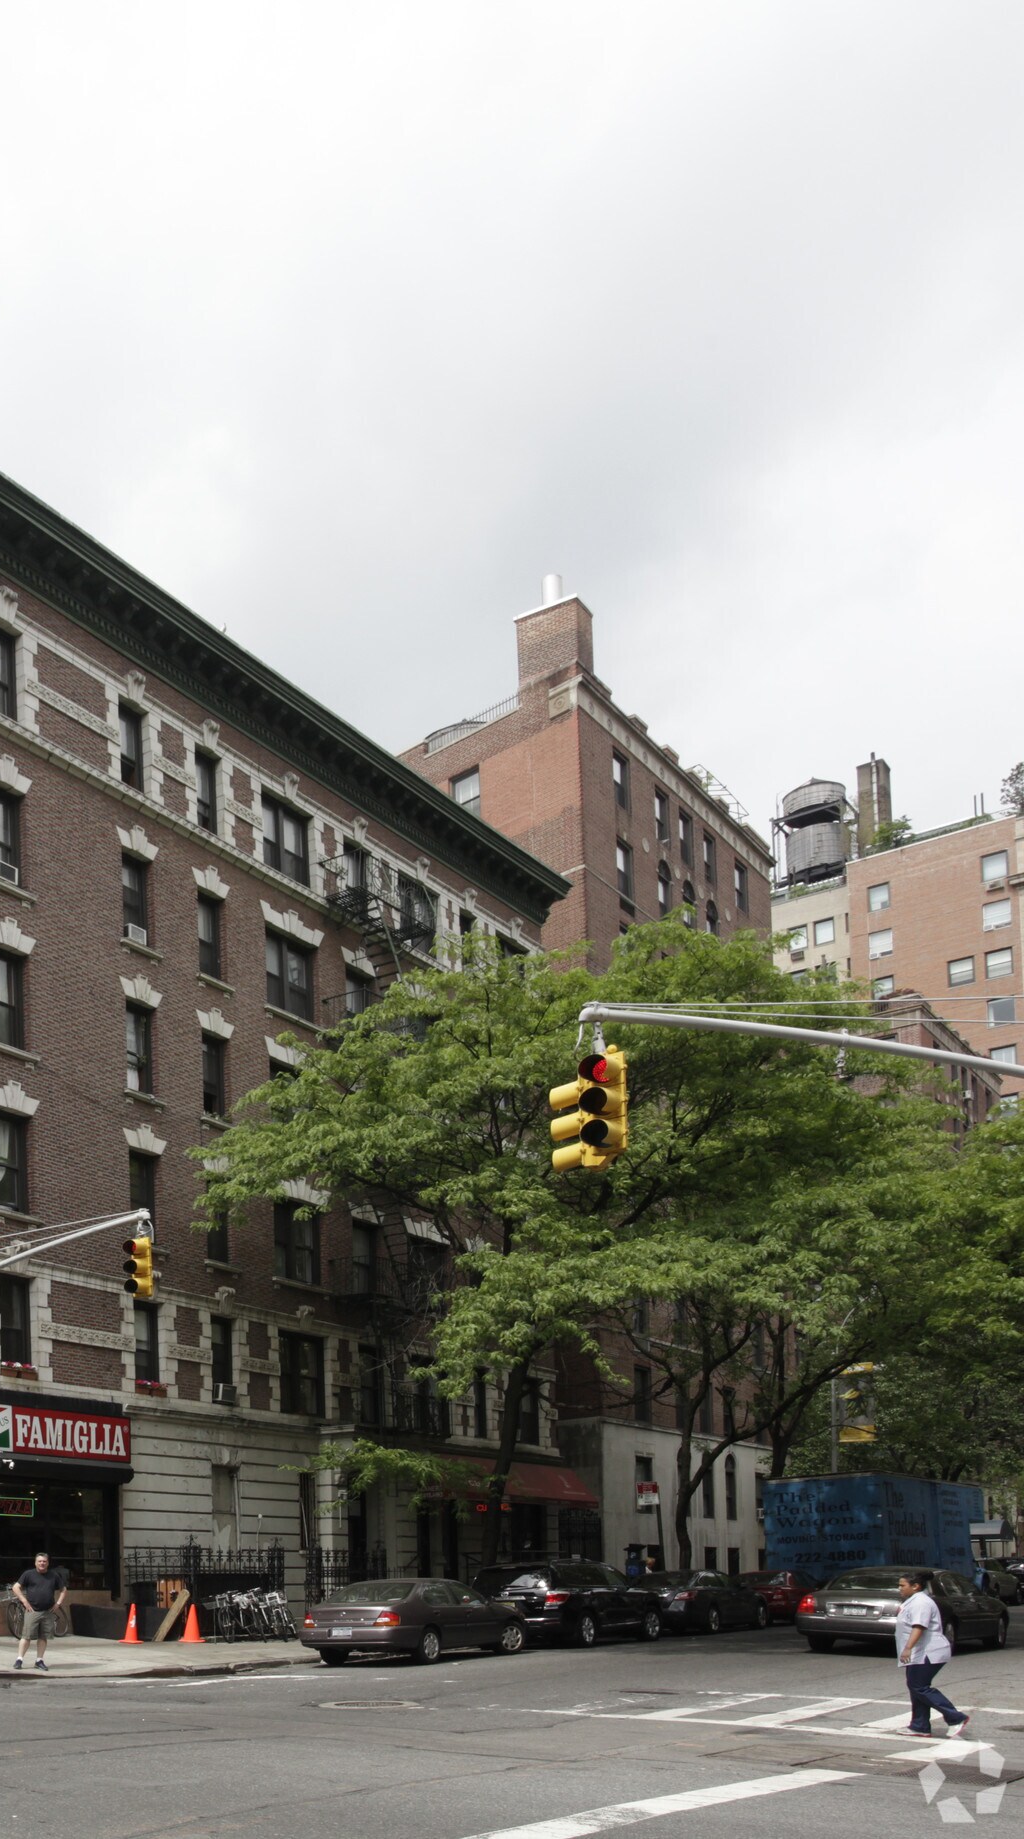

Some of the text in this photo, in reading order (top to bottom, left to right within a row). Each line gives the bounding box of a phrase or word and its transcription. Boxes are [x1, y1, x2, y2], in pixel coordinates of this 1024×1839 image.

[15, 1414, 126, 1456] FAMIGLIA
[774, 1492, 816, 1504] The
[883, 1480, 904, 1508] The
[776, 1500, 851, 1516] Padded
[776, 1515, 855, 1530] Wagon
[888, 1511, 928, 1537] Padded
[822, 1532, 872, 1542] STORAGE
